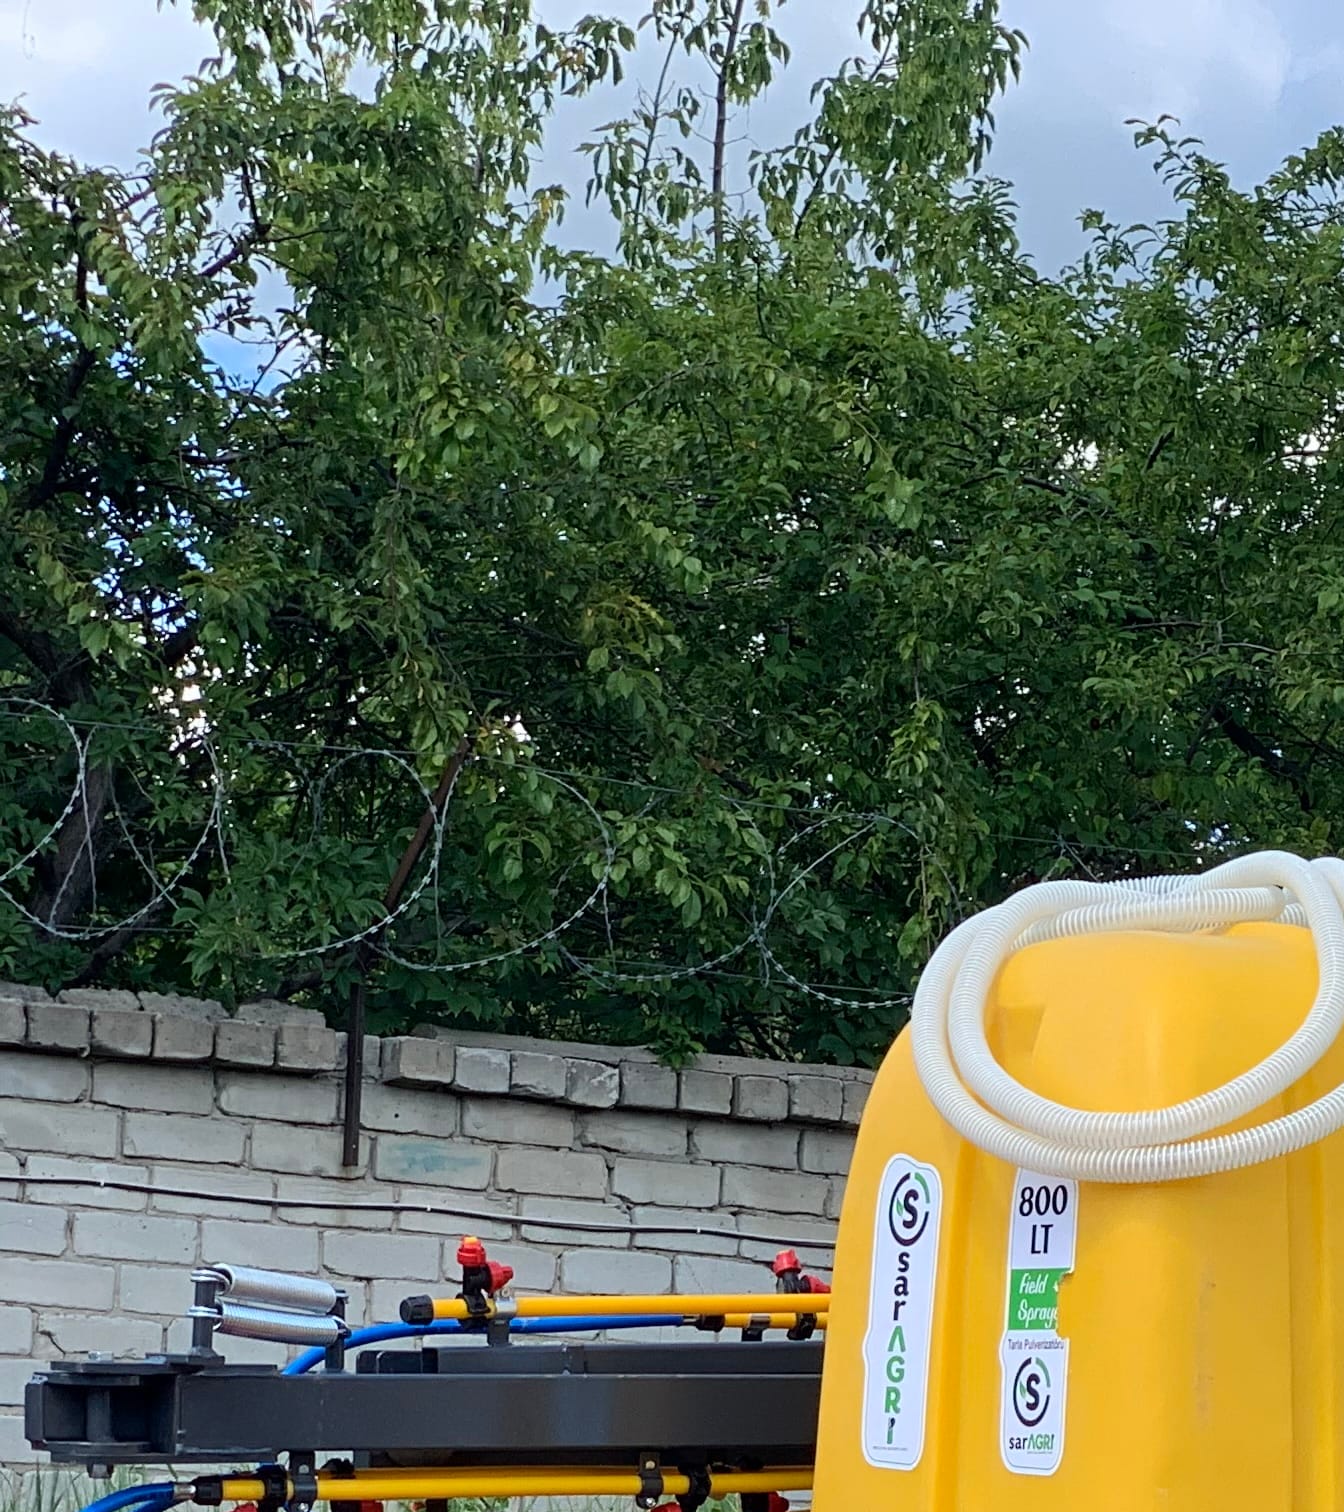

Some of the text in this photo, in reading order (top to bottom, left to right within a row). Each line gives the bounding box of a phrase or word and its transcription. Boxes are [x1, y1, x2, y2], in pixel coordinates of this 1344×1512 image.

[1019, 1185, 1068, 1217] 800
[1030, 1223, 1054, 1255] LT
[1018, 1273, 1048, 1295] Field
